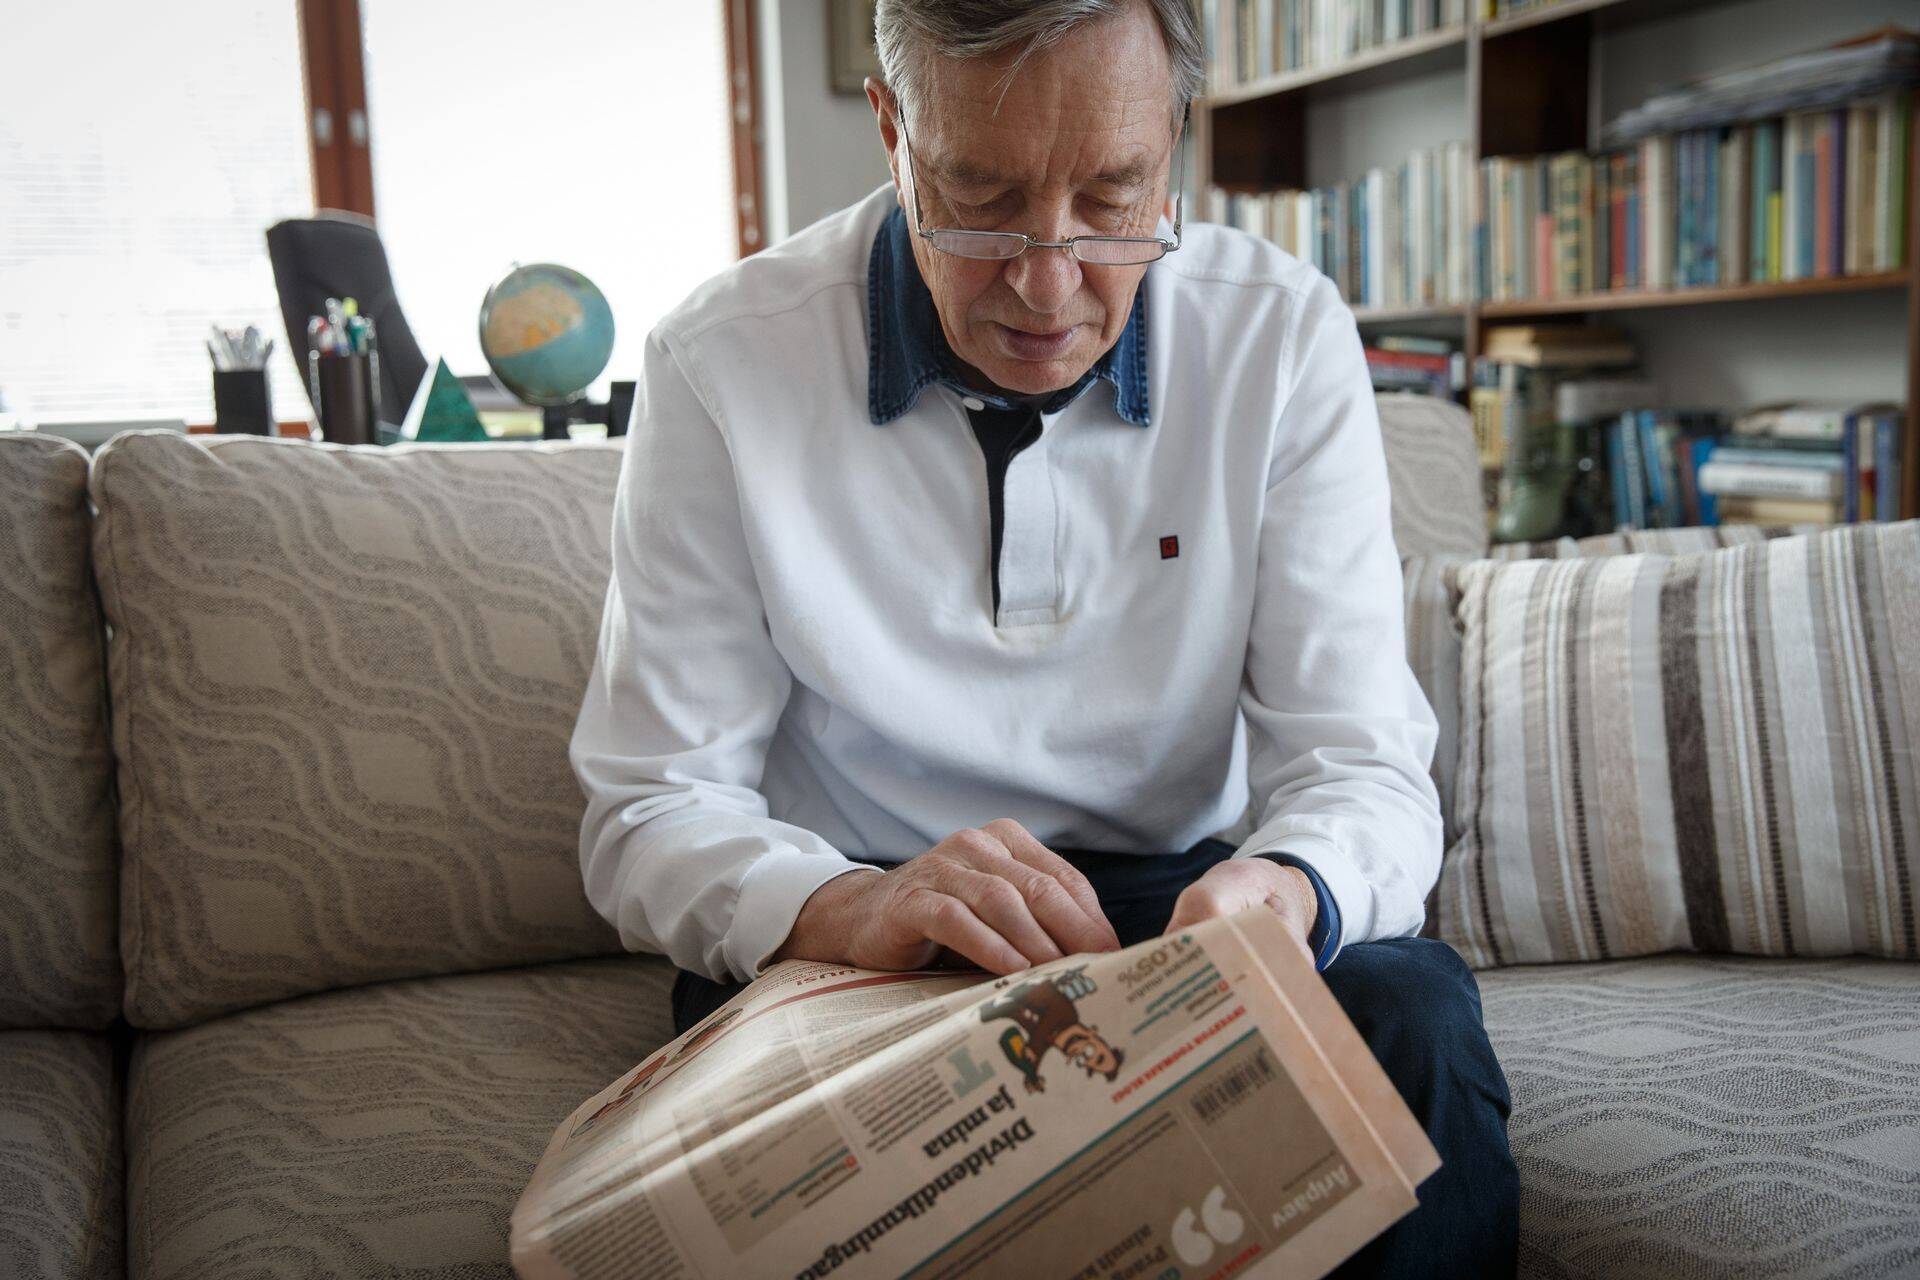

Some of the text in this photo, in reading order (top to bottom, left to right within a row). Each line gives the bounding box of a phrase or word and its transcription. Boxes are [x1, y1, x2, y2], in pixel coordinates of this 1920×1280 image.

[1117, 935, 1192, 988] +1.05%
[987, 1085, 1016, 1114] ja
[922, 1106, 990, 1159] mina
[1270, 1165, 1351, 1231] Äripäev
